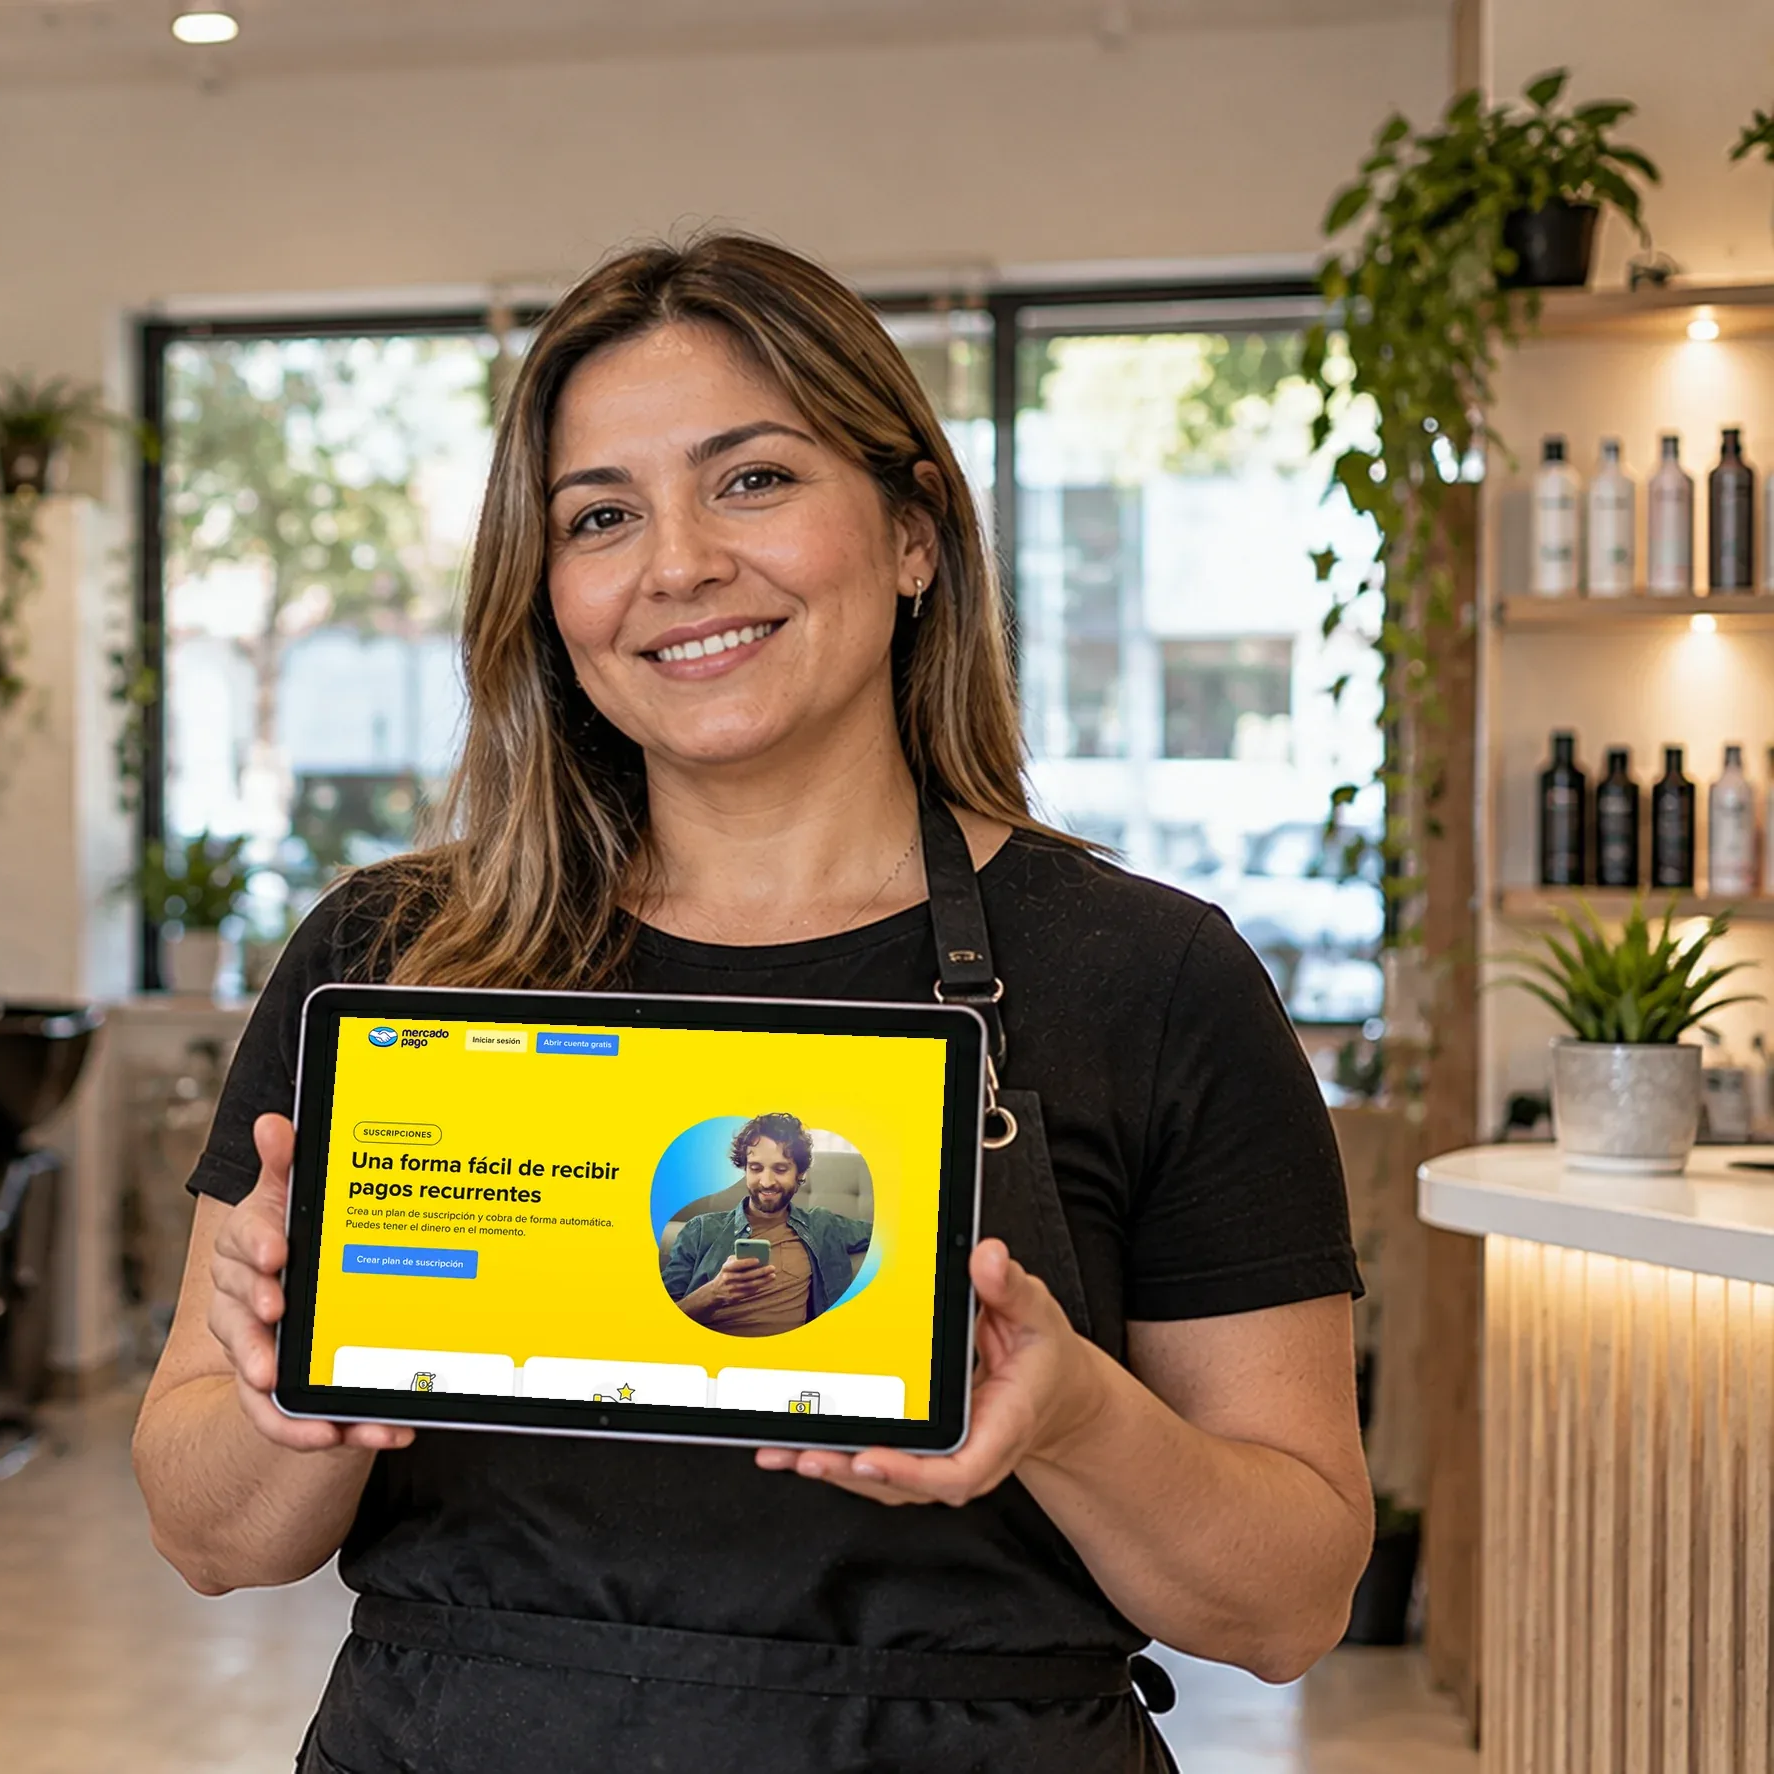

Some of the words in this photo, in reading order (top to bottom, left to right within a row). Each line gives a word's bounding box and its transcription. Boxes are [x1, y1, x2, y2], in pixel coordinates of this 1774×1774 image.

[401, 1028, 449, 1039] mercado
[401, 1037, 427, 1048] pago
[472, 1036, 495, 1044] Iniciar
[496, 1037, 521, 1045] sesión
[543, 1039, 562, 1047] Abrir
[591, 1041, 612, 1050] gratis
[363, 1128, 432, 1138] SUSCRIPCIONES
[351, 1151, 393, 1170] Una
[400, 1154, 461, 1173] forma
[468, 1156, 512, 1175] fácil
[518, 1159, 545, 1177] de
[551, 1161, 620, 1180] recibir
[349, 1181, 413, 1200] pagos
[420, 1185, 542, 1203] recurrentes
[347, 1206, 369, 1216] Crea
[385, 1208, 406, 1219] plan
[408, 1209, 420, 1218] de
[423, 1210, 475, 1222] suscripción
[478, 1214, 484, 1223] y
[486, 1213, 513, 1223] cobra
[515, 1214, 527, 1223] de
[530, 1215, 557, 1224] forma
[560, 1217, 614, 1227] automática.
[346, 1220, 381, 1230] Puedes
[383, 1222, 406, 1231] tener
[410, 1222, 418, 1231] el
[420, 1223, 451, 1233] dinero
[468, 1225, 476, 1234] el
[479, 1227, 526, 1237] momento.
[357, 1255, 380, 1264] Crear
[382, 1257, 400, 1267] plan
[402, 1257, 413, 1266] de
[415, 1258, 464, 1269] suscripción
